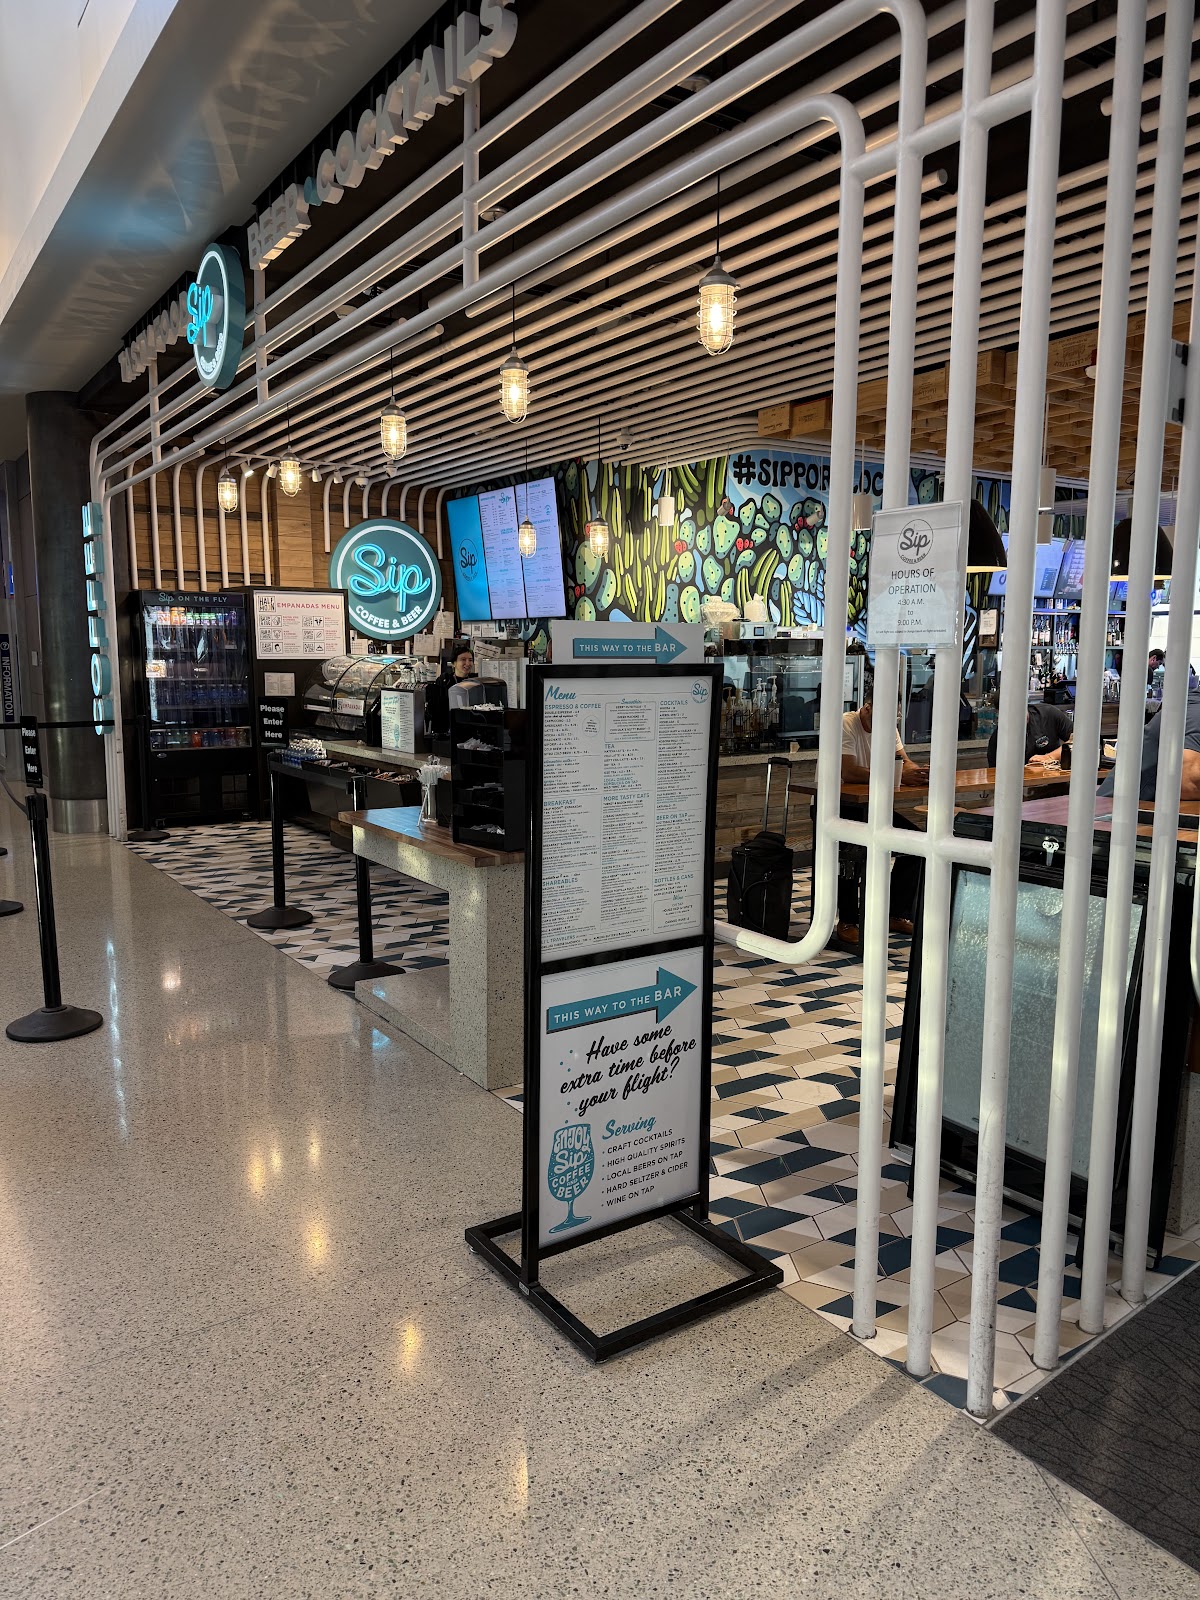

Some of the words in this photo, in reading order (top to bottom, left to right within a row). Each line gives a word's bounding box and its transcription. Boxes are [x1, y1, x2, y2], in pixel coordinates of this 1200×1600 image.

[247, 183, 311, 270] BEER
[316, 0, 518, 204] COCKTAILS
[187, 282, 213, 347] Sip
[900, 528, 930, 556] Sip
[461, 547, 477, 574] Sip
[348, 544, 430, 612] Sip
[891, 569, 920, 580] HOURS
[923, 568, 934, 578] OF
[159, 592, 174, 604] Sip
[888, 584, 936, 595] OPERATION
[356, 605, 389, 628] COFFEE
[392, 619, 400, 628] &
[401, 606, 422, 625] BEER
[655, 643, 676, 652] BAR
[2, 657, 13, 716] INFORMATION
[545, 685, 577, 701] Menu
[693, 683, 708, 700] Sip
[22, 728, 36, 737] Please
[25, 746, 37, 755] Enter
[27, 764, 38, 773] Here
[544, 799, 576, 807] BREAKFAST
[543, 878, 579, 887] SHAREABLES
[554, 1011, 580, 1024] THIS
[585, 1004, 608, 1017] WAY
[613, 1001, 626, 1011] TO
[631, 995, 650, 1007] THE
[655, 986, 682, 1002] BAR
[586, 1036, 629, 1064] Have
[634, 1026, 672, 1046] some
[560, 1071, 604, 1094] extra
[609, 1057, 644, 1077] time
[650, 1039, 696, 1063] before
[578, 1088, 619, 1117] your
[622, 1056, 680, 1100] flight?
[554, 1126, 591, 1153] ENJOY
[602, 1117, 657, 1140] Serving
[608, 1142, 632, 1154] CRAFT
[634, 1129, 673, 1146] COCKTAILS
[608, 1156, 625, 1168] HIGH
[628, 1146, 659, 1161] QUALITY
[660, 1138, 686, 1151] SPIRITS
[554, 1150, 587, 1174] Sip
[607, 1169, 631, 1181] LOCAL
[634, 1160, 656, 1172] BEERS
[670, 1151, 683, 1160] TAP
[552, 1163, 591, 1188] COFFEE
[557, 1176, 588, 1198] BEER
[607, 1182, 628, 1194] HARD
[630, 1171, 660, 1187] SELTZER
[668, 1162, 688, 1173] CIDER
[607, 1195, 626, 1207] WINE
[628, 1191, 639, 1200] ON
[642, 1186, 655, 1195] TAP
